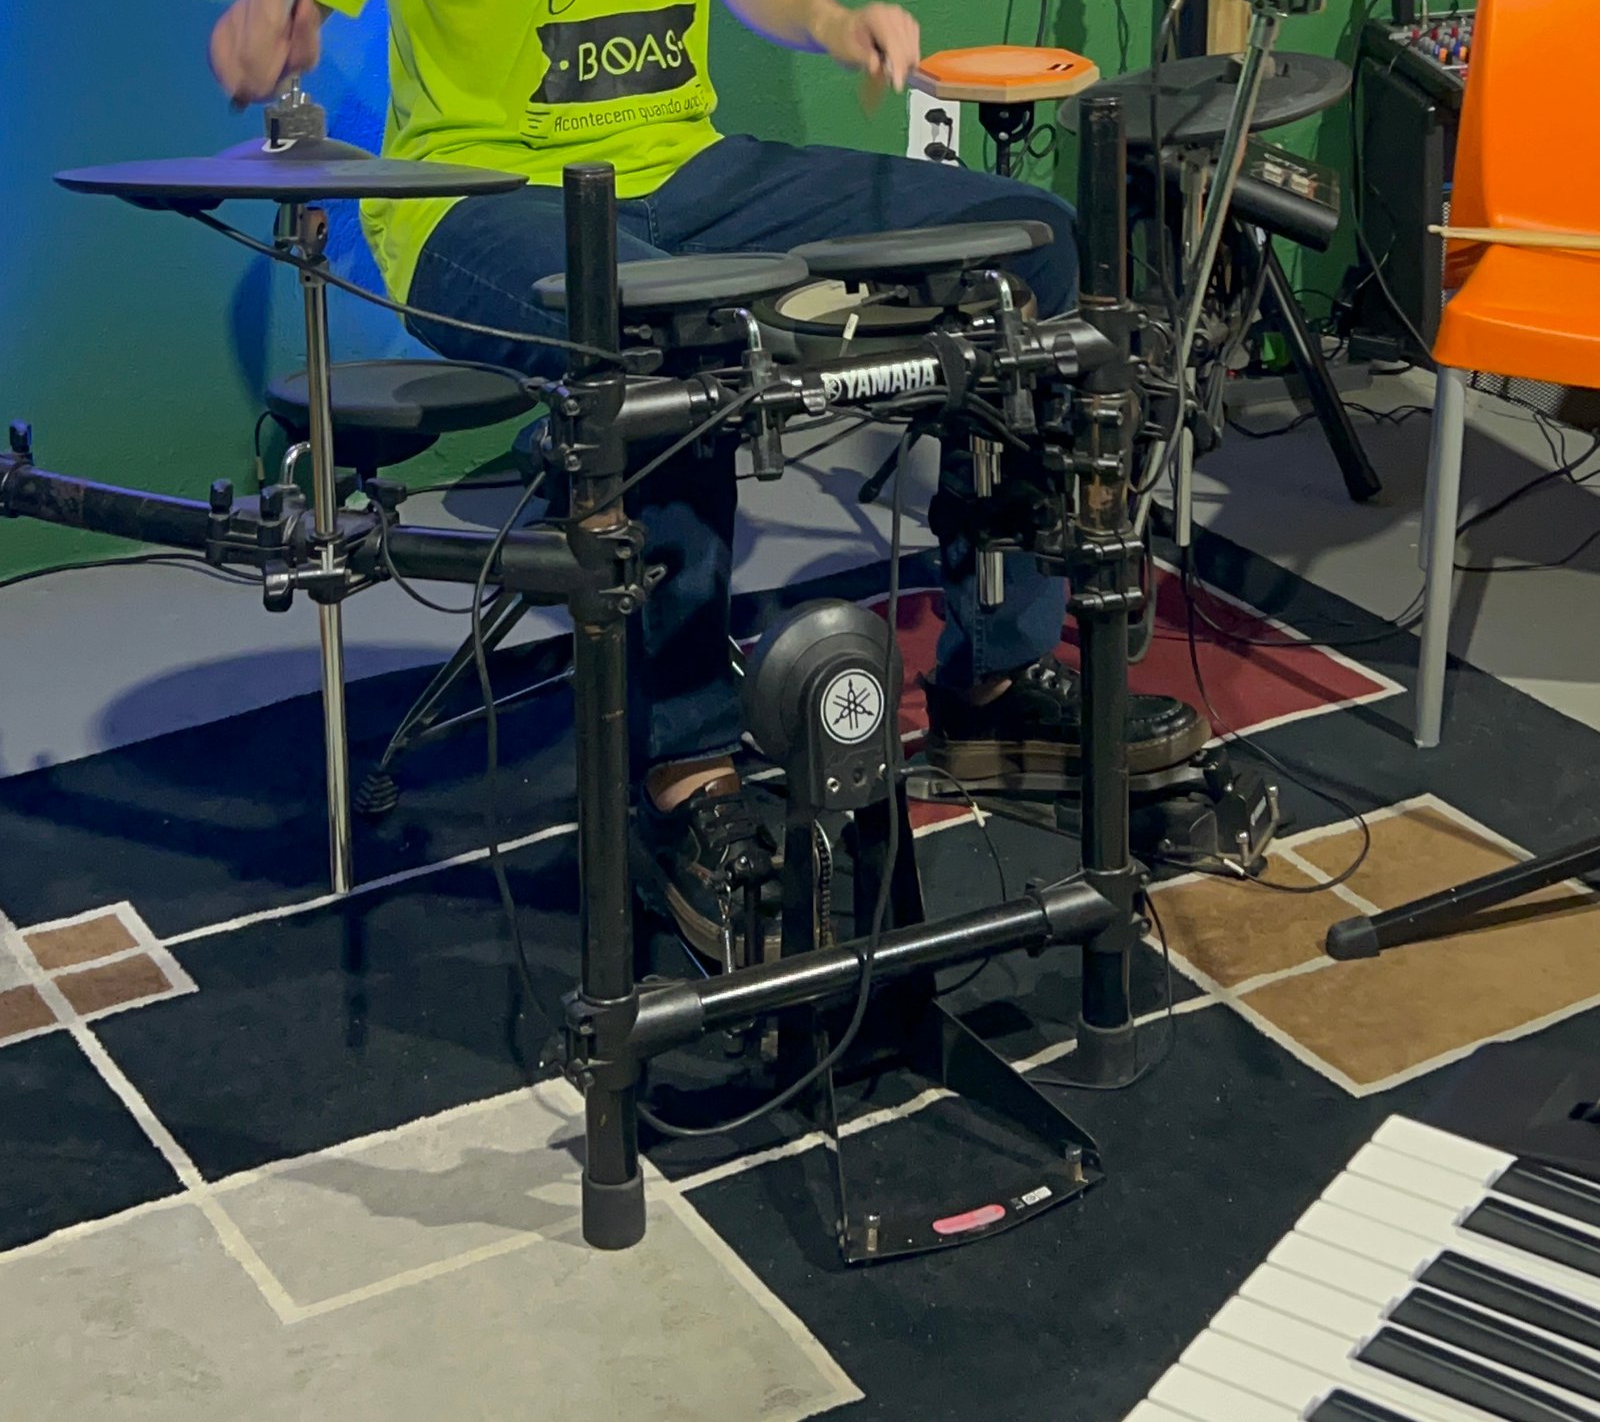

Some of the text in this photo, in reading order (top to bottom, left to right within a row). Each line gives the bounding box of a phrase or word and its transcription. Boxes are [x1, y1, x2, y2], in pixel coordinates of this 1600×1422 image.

[554, 107, 636, 133] Acontecem
[639, 97, 682, 123] quando
[841, 358, 936, 399] YAMAHA
